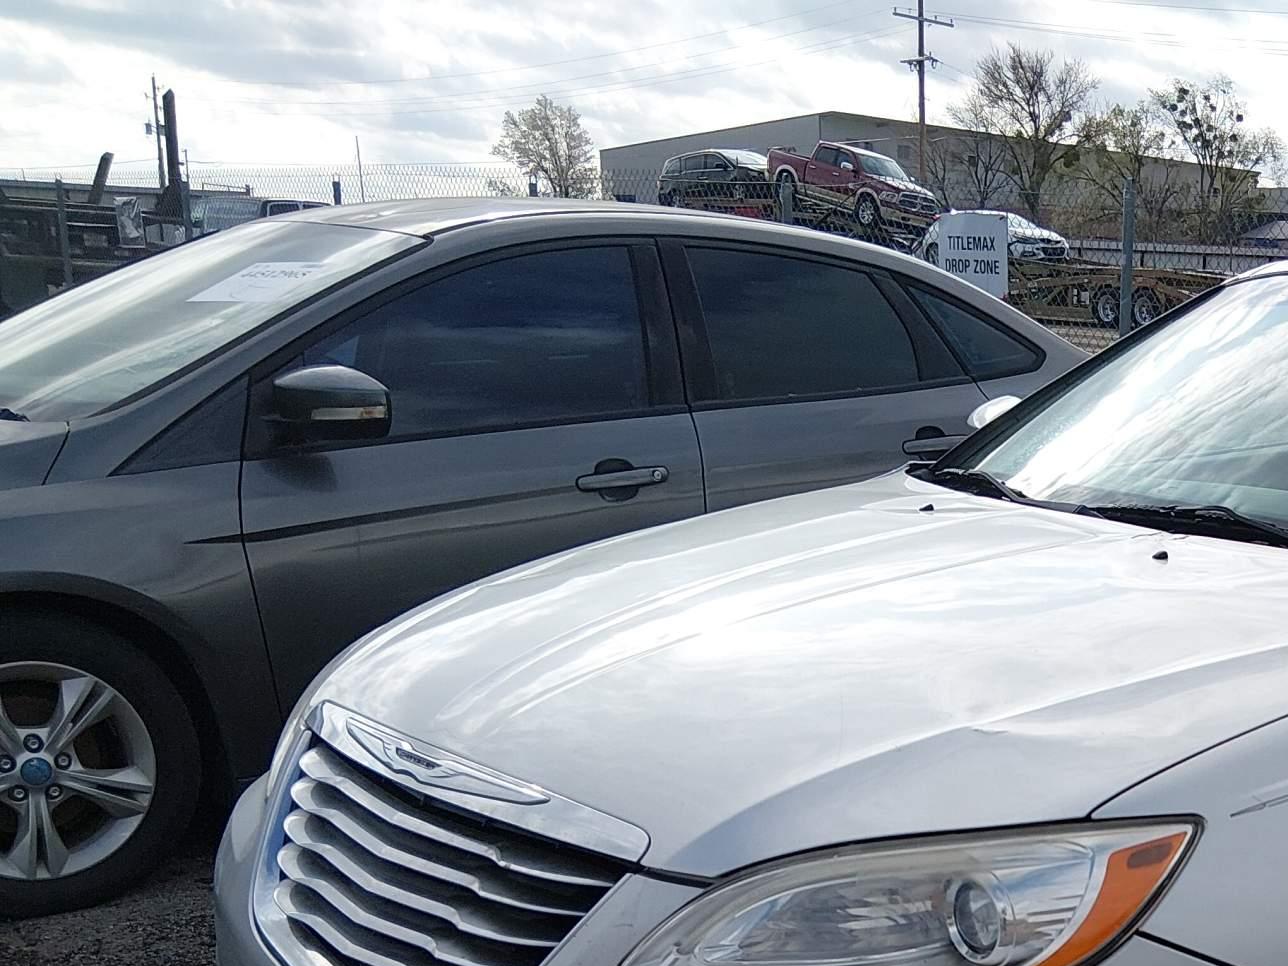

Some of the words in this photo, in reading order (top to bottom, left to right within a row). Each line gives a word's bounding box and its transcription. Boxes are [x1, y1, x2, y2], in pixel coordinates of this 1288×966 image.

[948, 235, 996, 252] TITLEMAX
[945, 258, 970, 274] DROP
[974, 259, 1000, 274] ZONE
